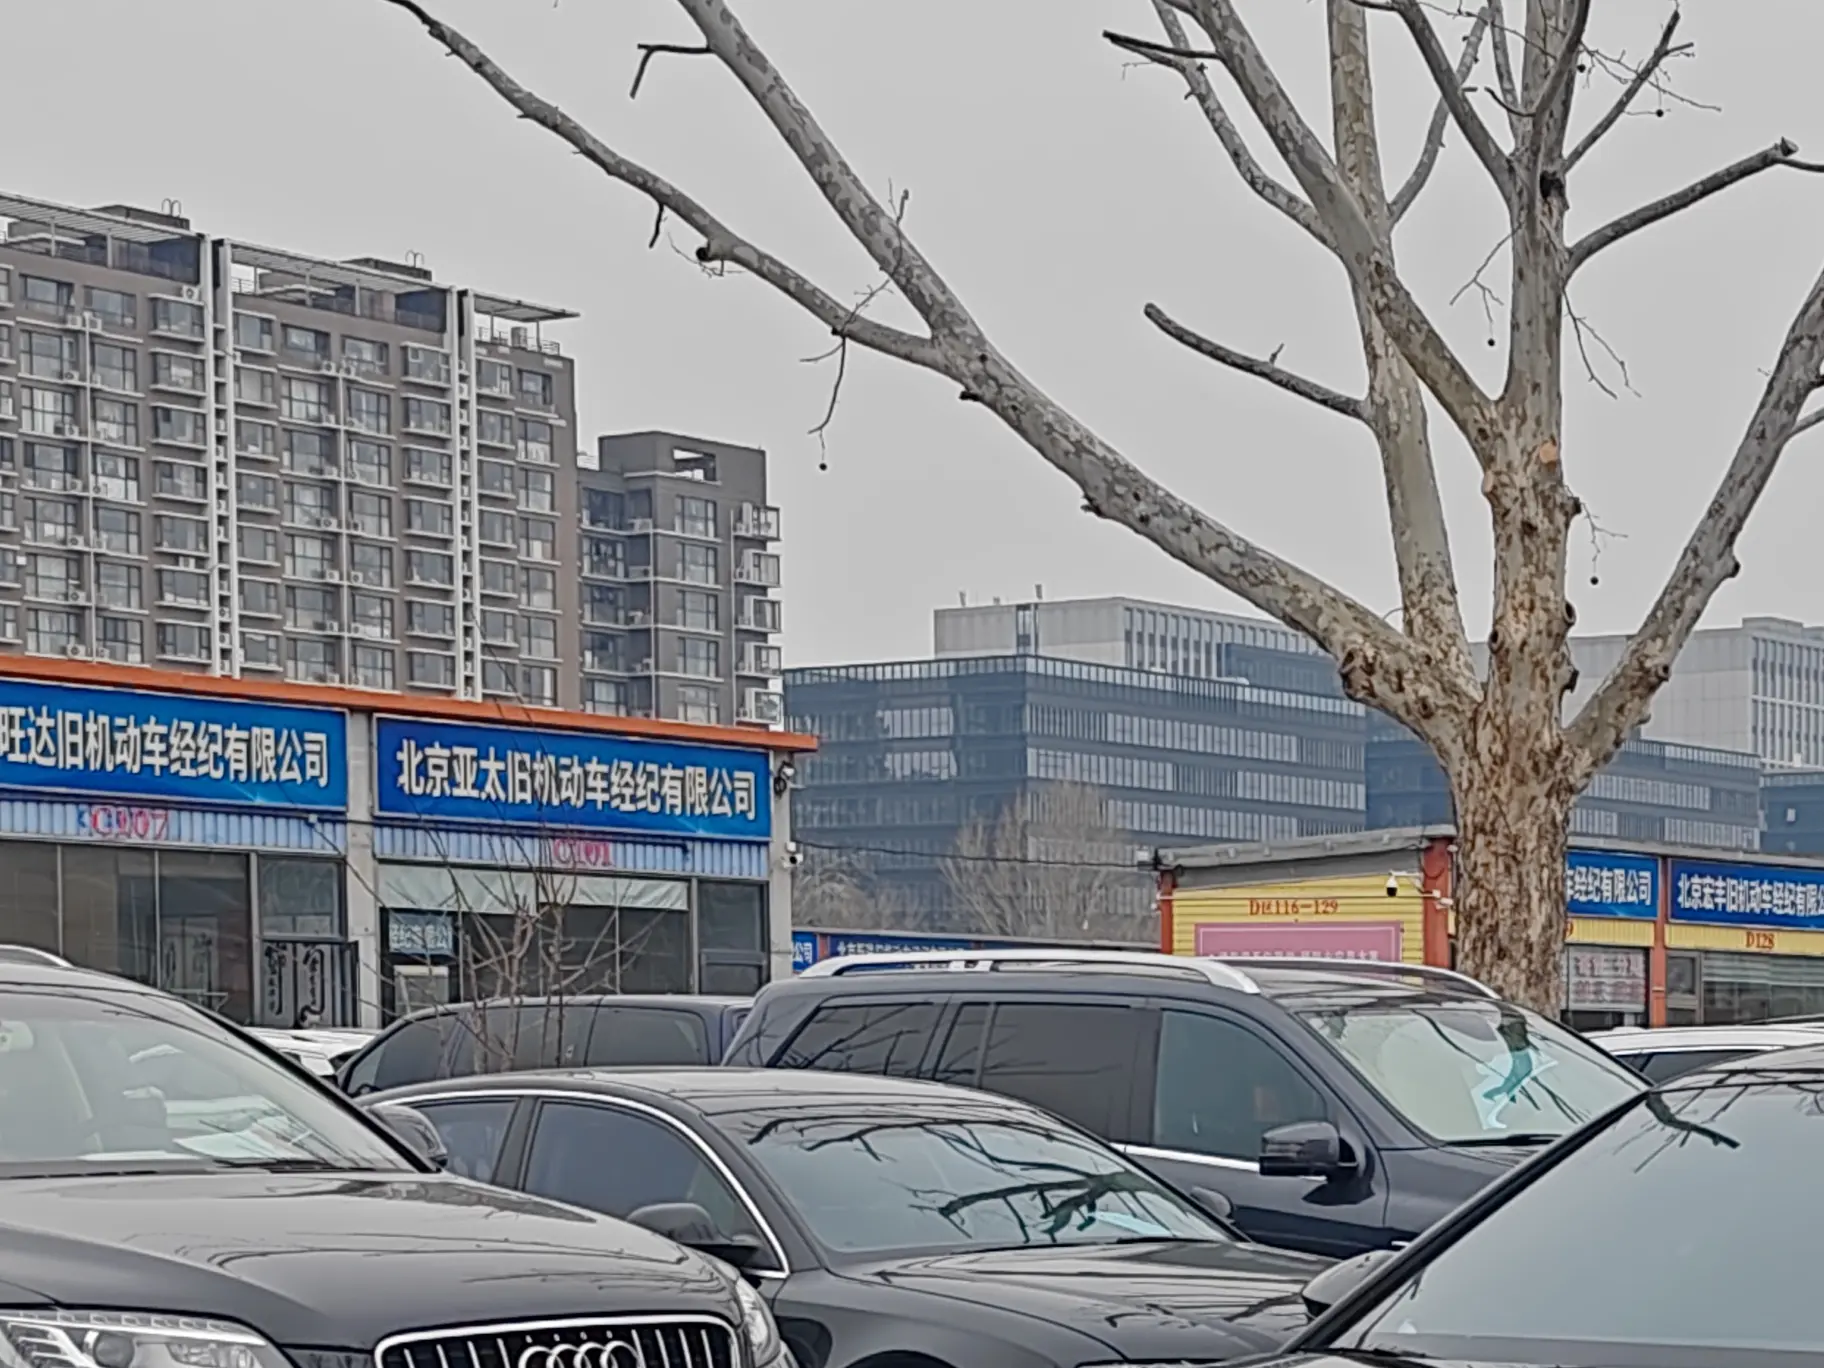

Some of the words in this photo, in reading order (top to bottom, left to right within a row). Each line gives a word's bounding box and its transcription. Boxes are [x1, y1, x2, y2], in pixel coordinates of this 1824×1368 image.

[0, 705, 329, 788] 旺达旧机动车经纪有限公司
[395, 738, 756, 821] 北京亚太旧机动车经纪有限公司
[1746, 932, 1775, 950] D128
